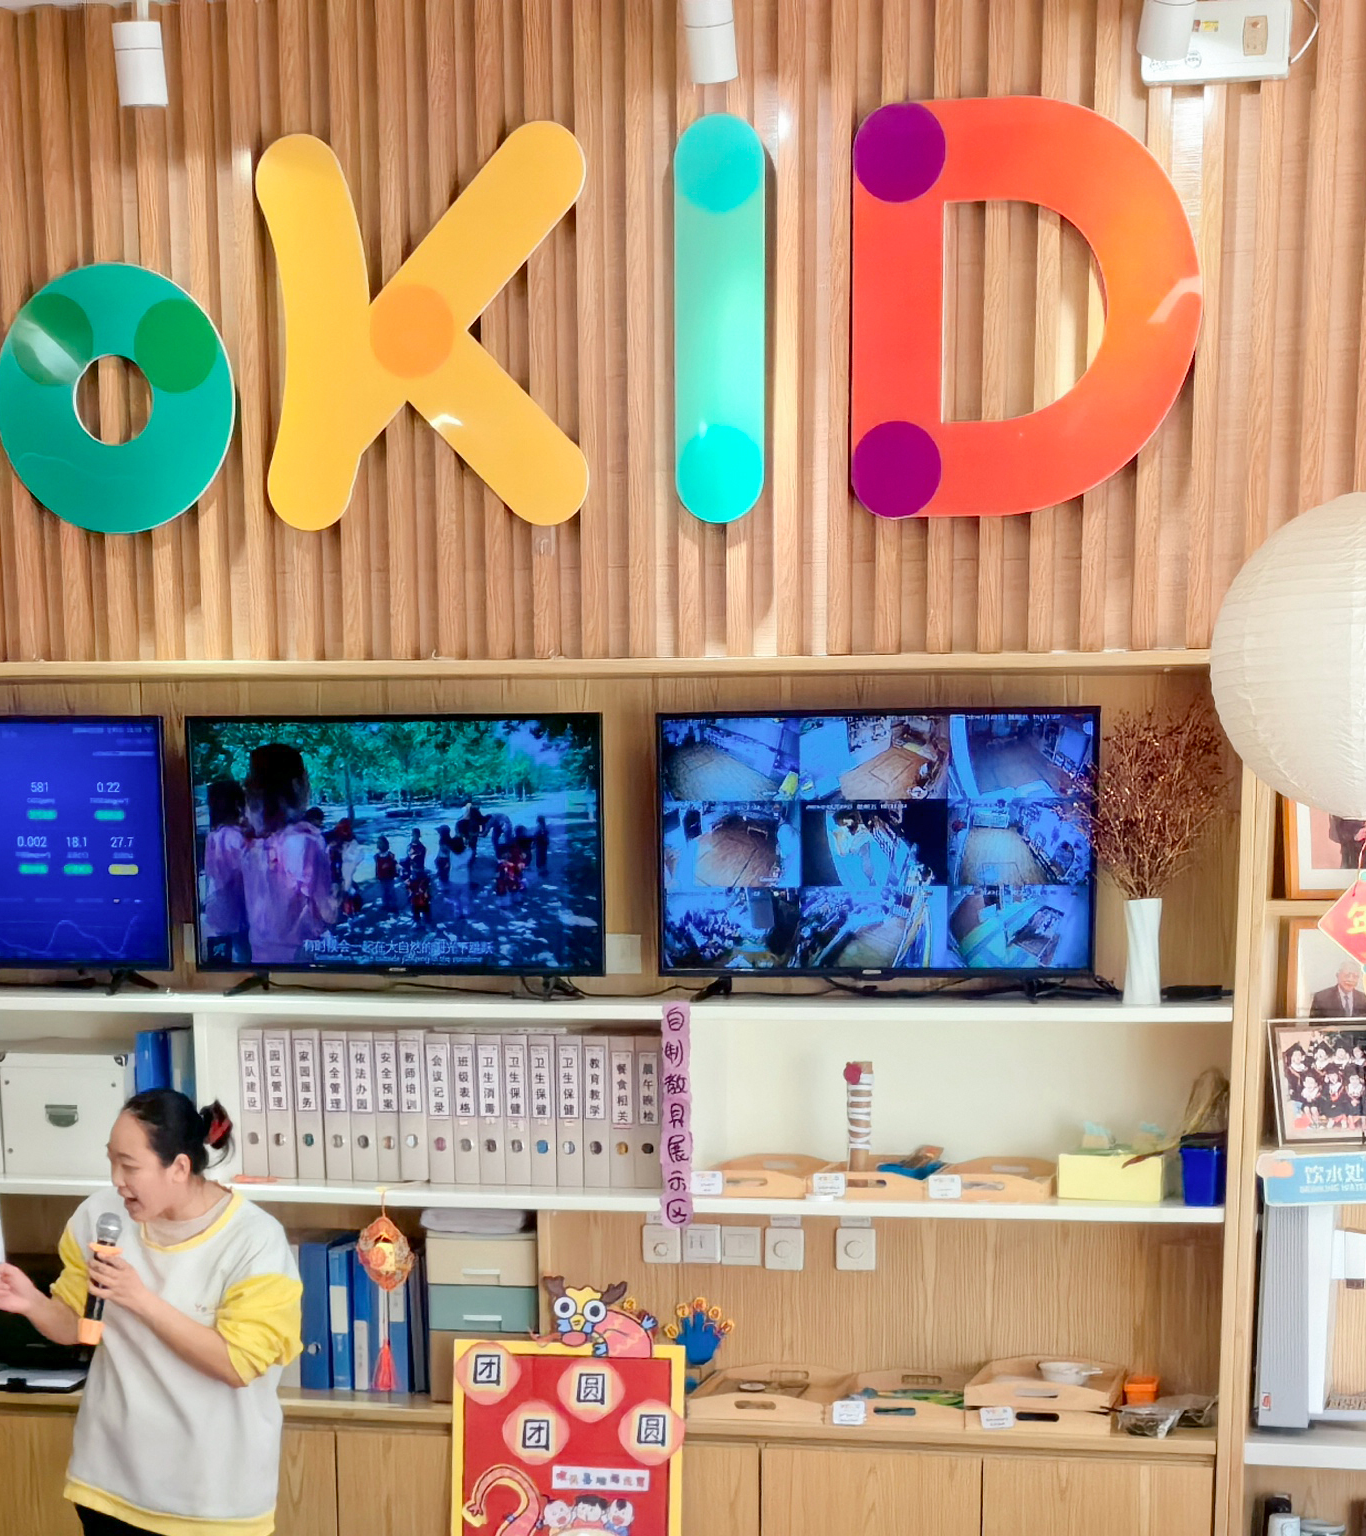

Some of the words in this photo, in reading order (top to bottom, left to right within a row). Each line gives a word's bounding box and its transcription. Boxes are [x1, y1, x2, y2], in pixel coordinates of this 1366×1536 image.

[30, 781, 49, 793] 581
[96, 781, 121, 793] 0.22
[17, 836, 47, 848] 0.002
[66, 836, 88, 848] 18.1
[110, 836, 134, 848] 27.7
[243, 1049, 259, 1109] 团队建设
[328, 1051, 342, 1110] 安全管理
[354, 1051, 369, 1111] 依法办园
[430, 1054, 446, 1114] 会议记录
[457, 1055, 472, 1115] 班级表格
[508, 1056, 522, 1116] 卫生保健
[534, 1056, 548, 1117] 卫生保健
[562, 1056, 576, 1117] 卫生保健
[588, 1057, 602, 1118] 教育教学
[663, 1006, 691, 1224] 自制教具展示区
[1304, 1162, 1366, 1184] 饮水处
[472, 1353, 502, 1387] 团
[575, 1372, 606, 1406] 圆
[521, 1418, 550, 1452] 团
[636, 1413, 667, 1448] 圆
